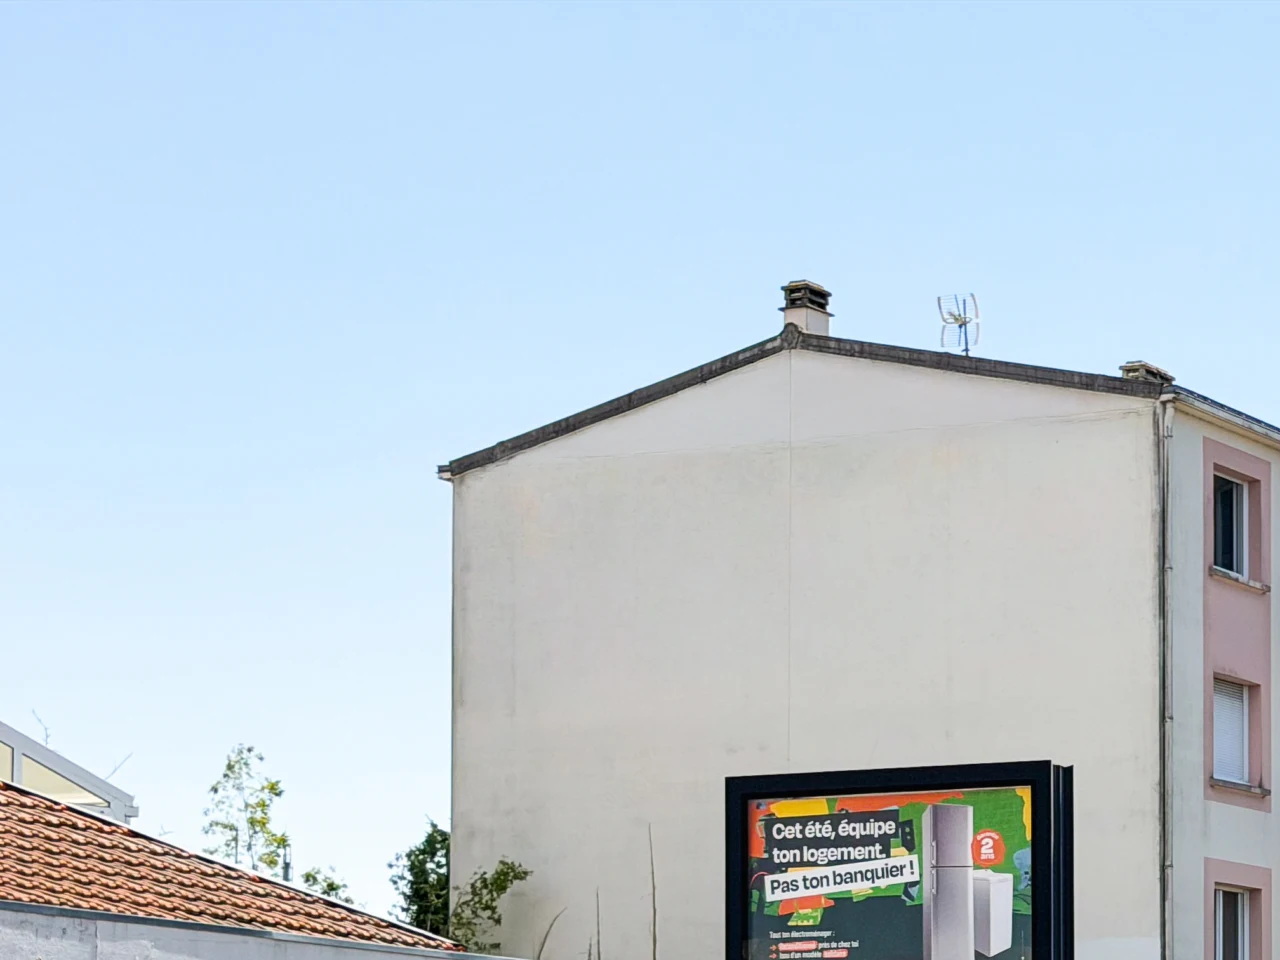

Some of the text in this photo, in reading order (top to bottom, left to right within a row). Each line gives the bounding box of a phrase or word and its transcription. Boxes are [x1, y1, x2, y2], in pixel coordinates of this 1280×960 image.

[772, 819, 896, 840] Cet été, équipe
[772, 843, 886, 864] ton logement.
[981, 838, 994, 854] 2
[770, 879, 800, 896] Pas
[802, 872, 830, 890] ton
[832, 863, 907, 886] banquier
